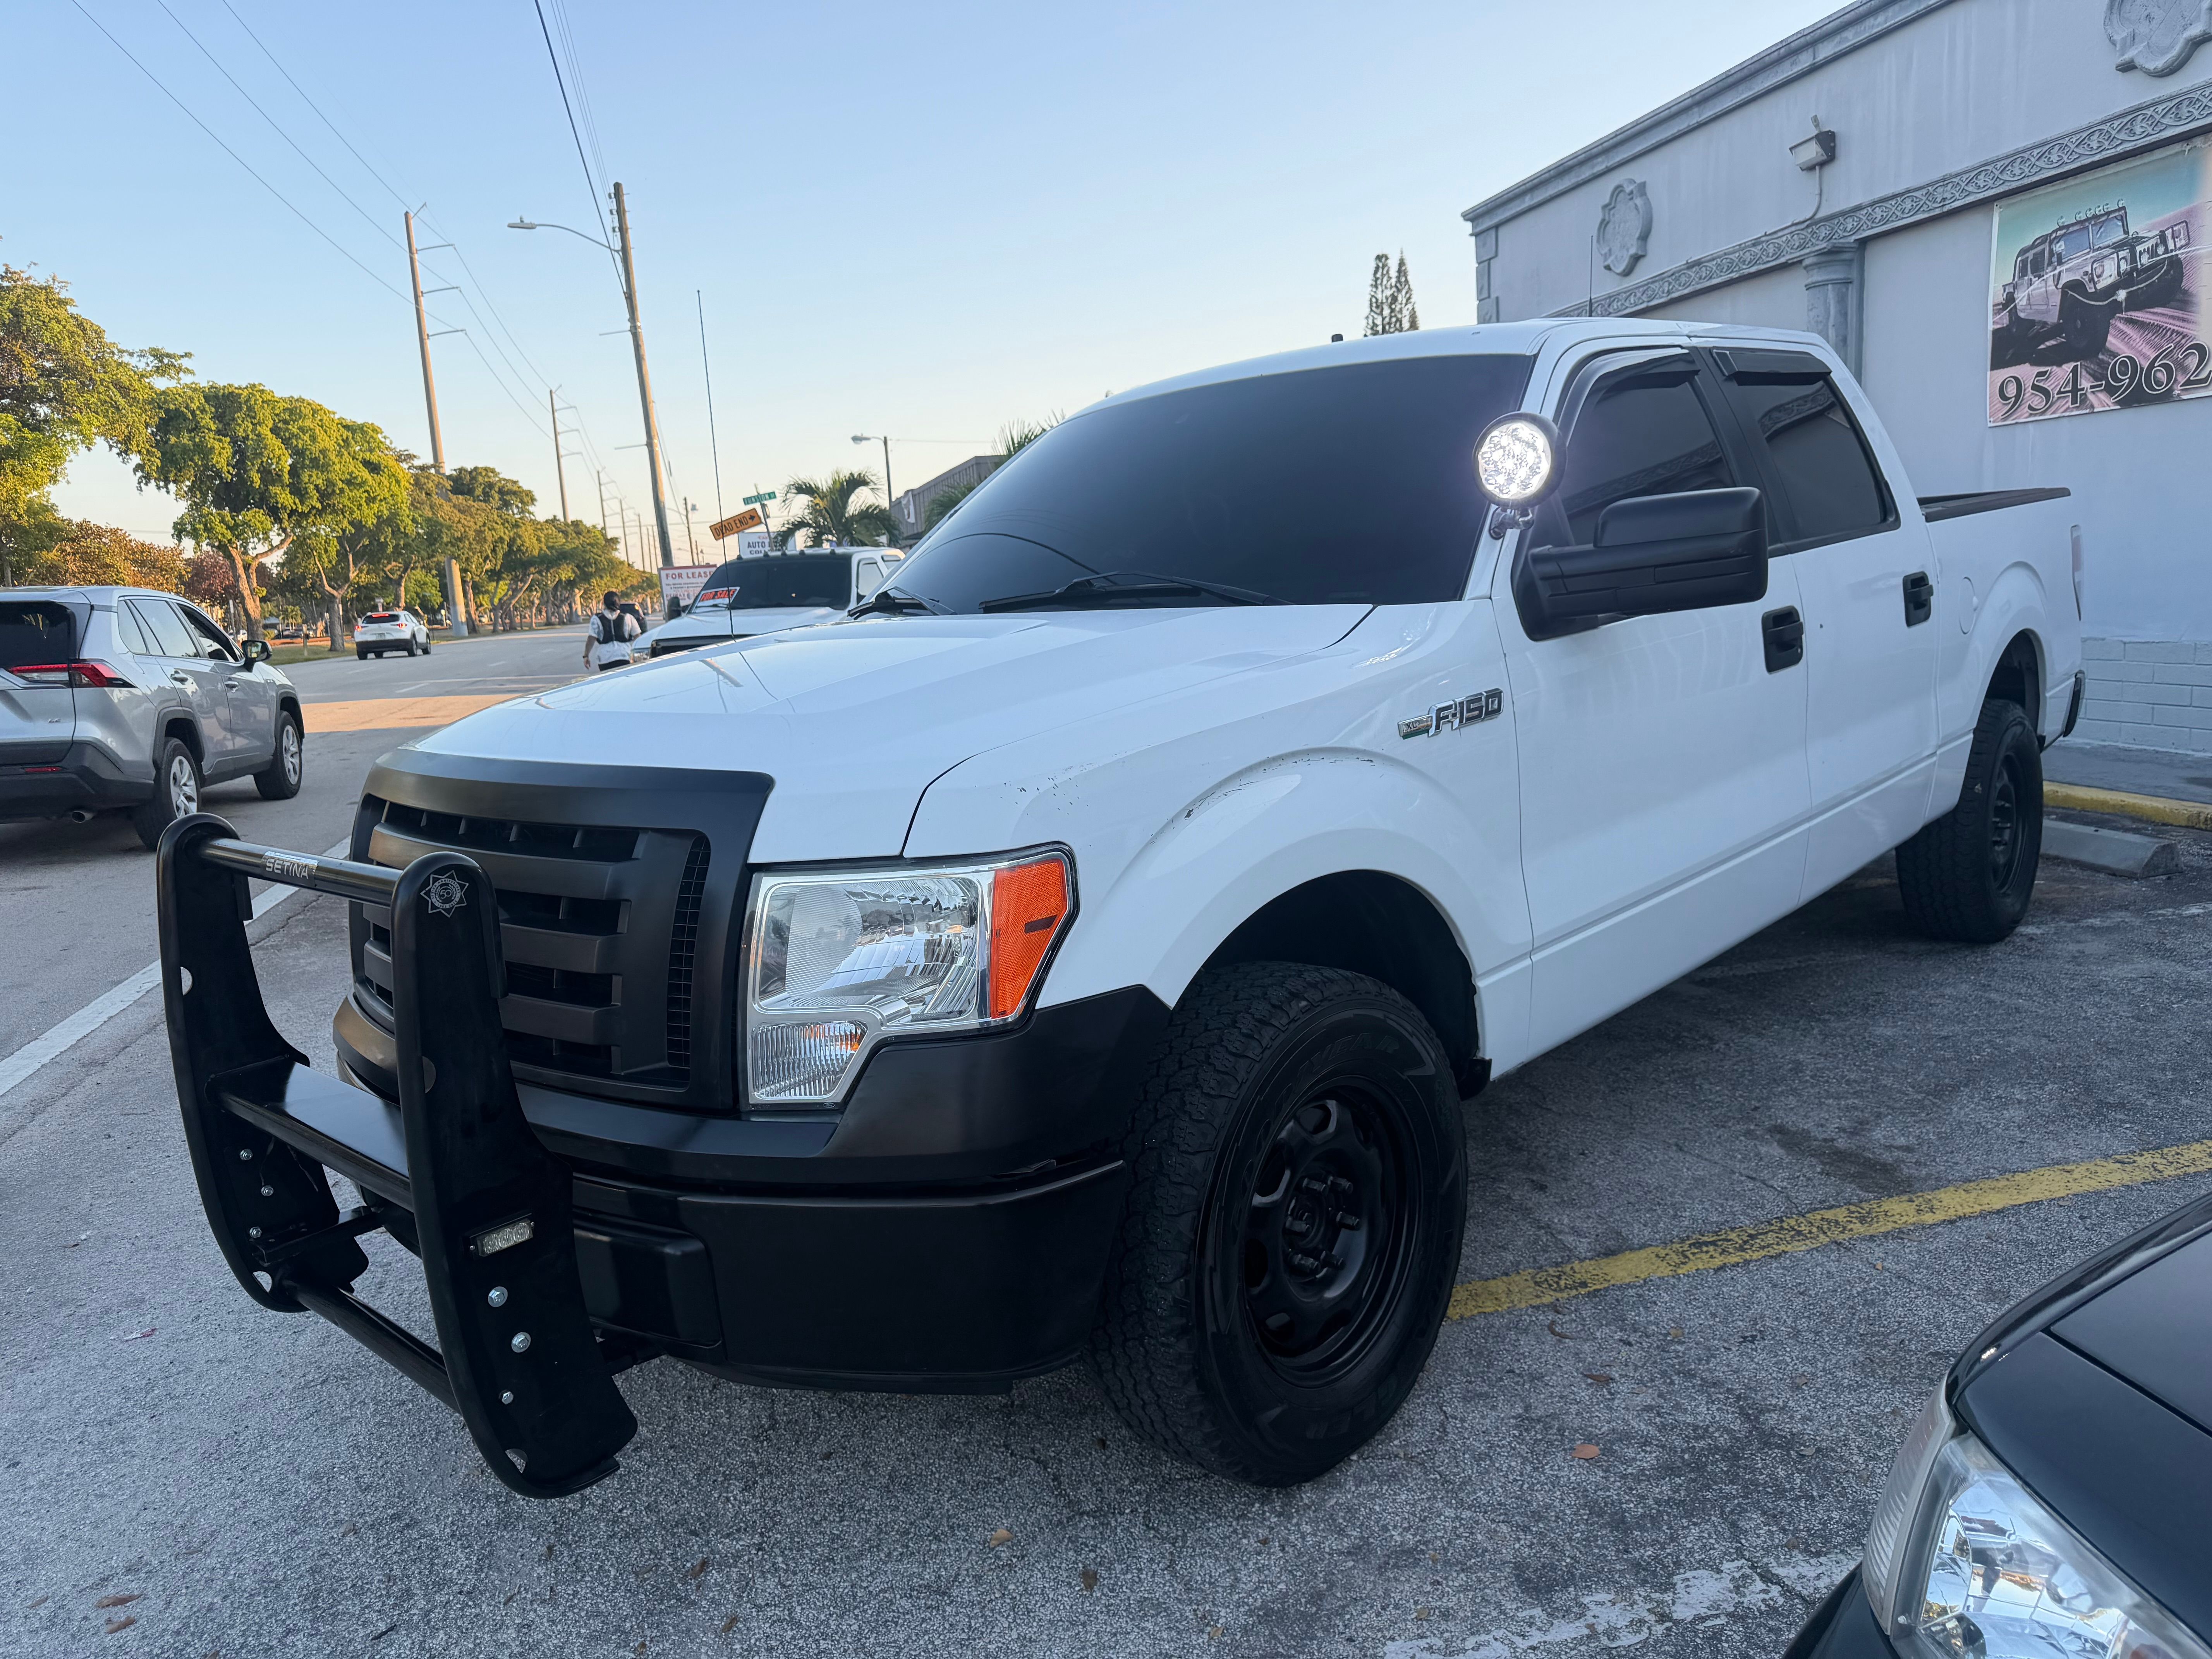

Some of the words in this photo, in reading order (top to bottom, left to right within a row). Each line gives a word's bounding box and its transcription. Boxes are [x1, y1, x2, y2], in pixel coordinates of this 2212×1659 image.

[714, 522, 733, 537] DEAD
[734, 515, 749, 529] END
[747, 541, 766, 549] AUTO
[700, 591, 716, 602] FOR
[266, 858, 309, 879] SETINA
[440, 889, 452, 899] 50
